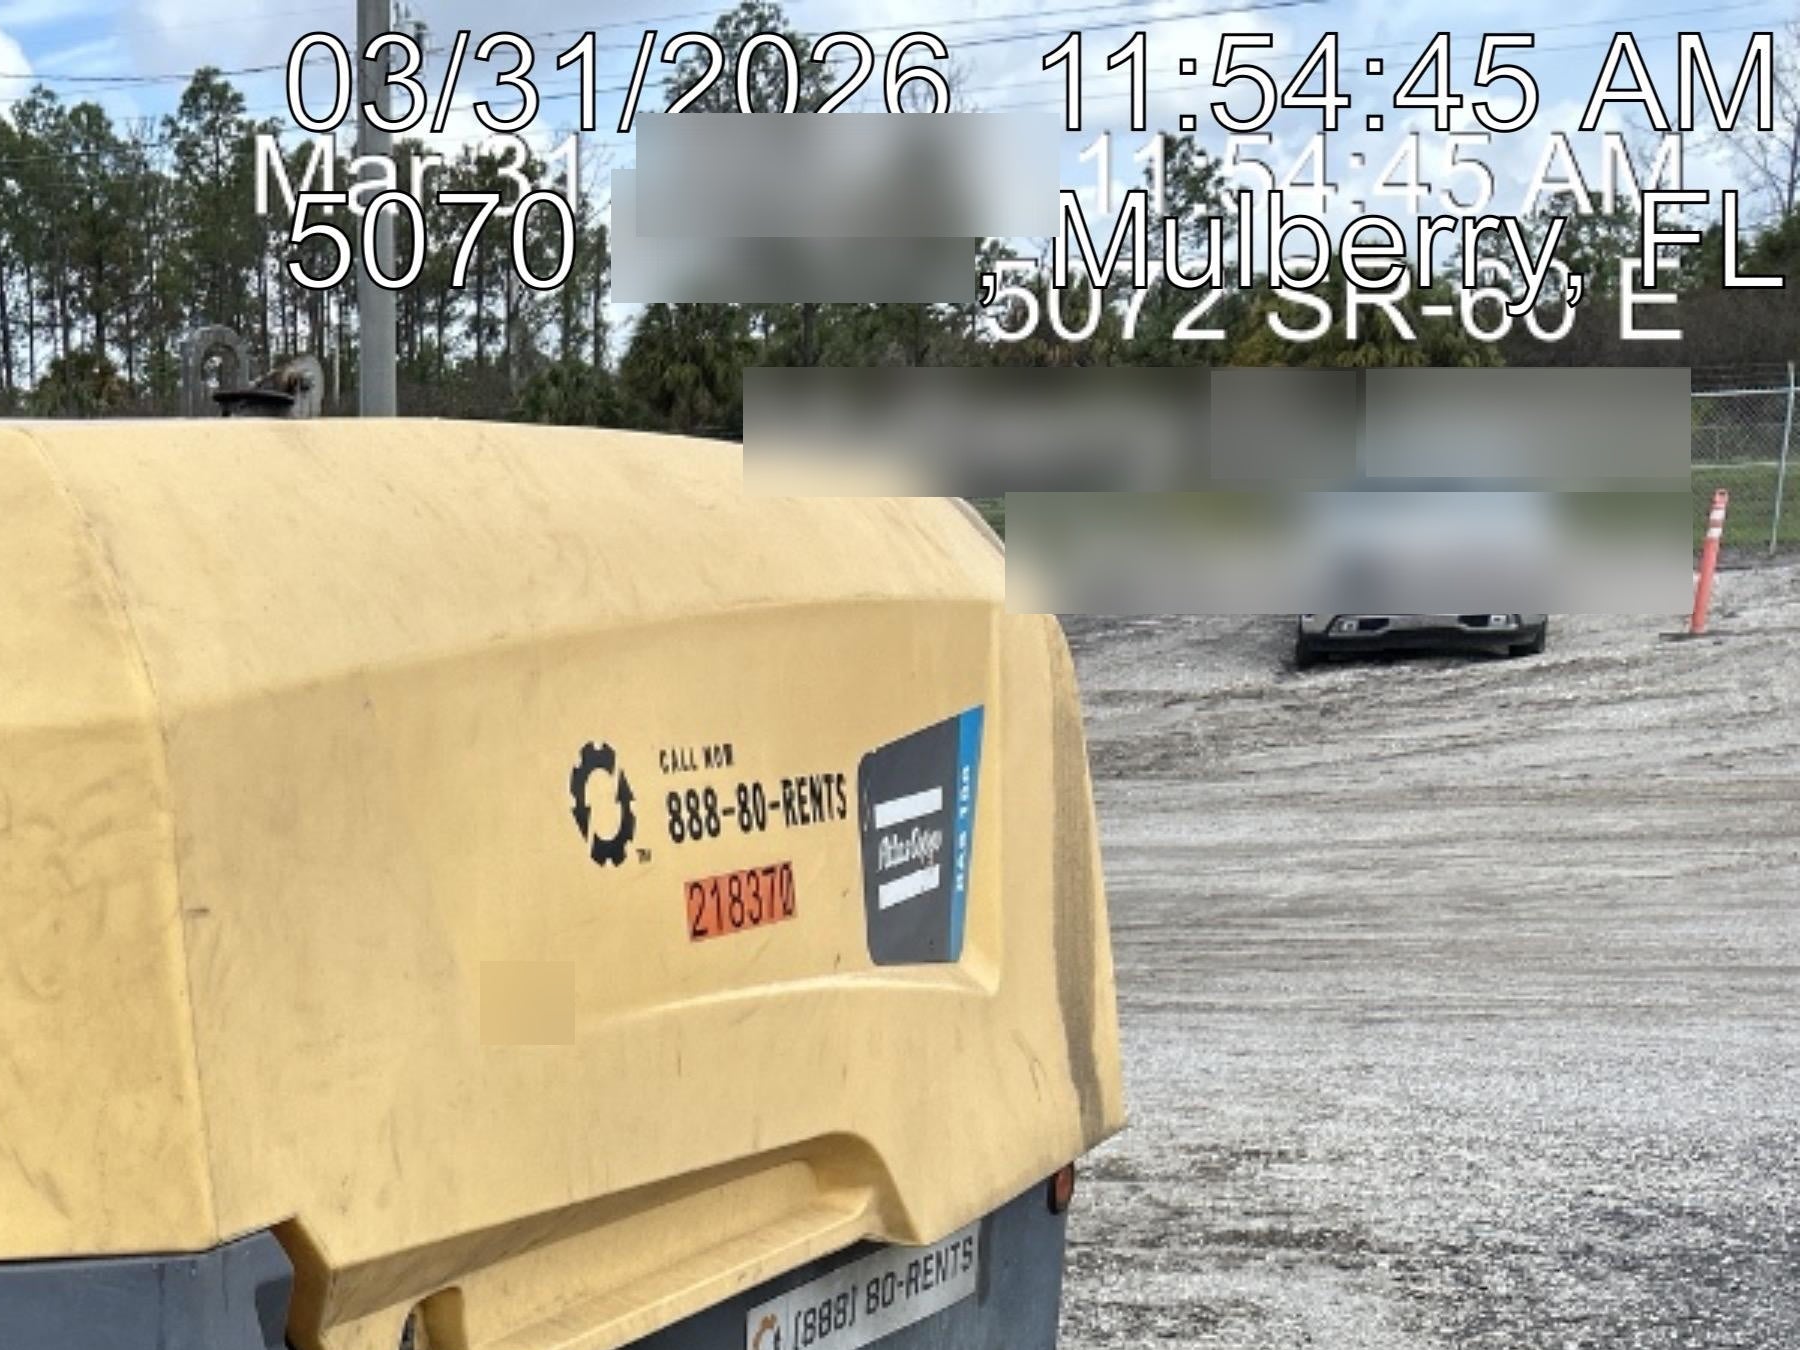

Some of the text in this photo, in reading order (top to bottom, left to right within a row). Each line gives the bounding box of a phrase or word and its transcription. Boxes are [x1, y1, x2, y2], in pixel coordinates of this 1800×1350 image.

[659, 743, 734, 775] CALL NOW
[666, 773, 849, 844] 888-80-RENTS
[688, 862, 795, 938] 218370
[865, 1235, 974, 1315] 80-RENTS
